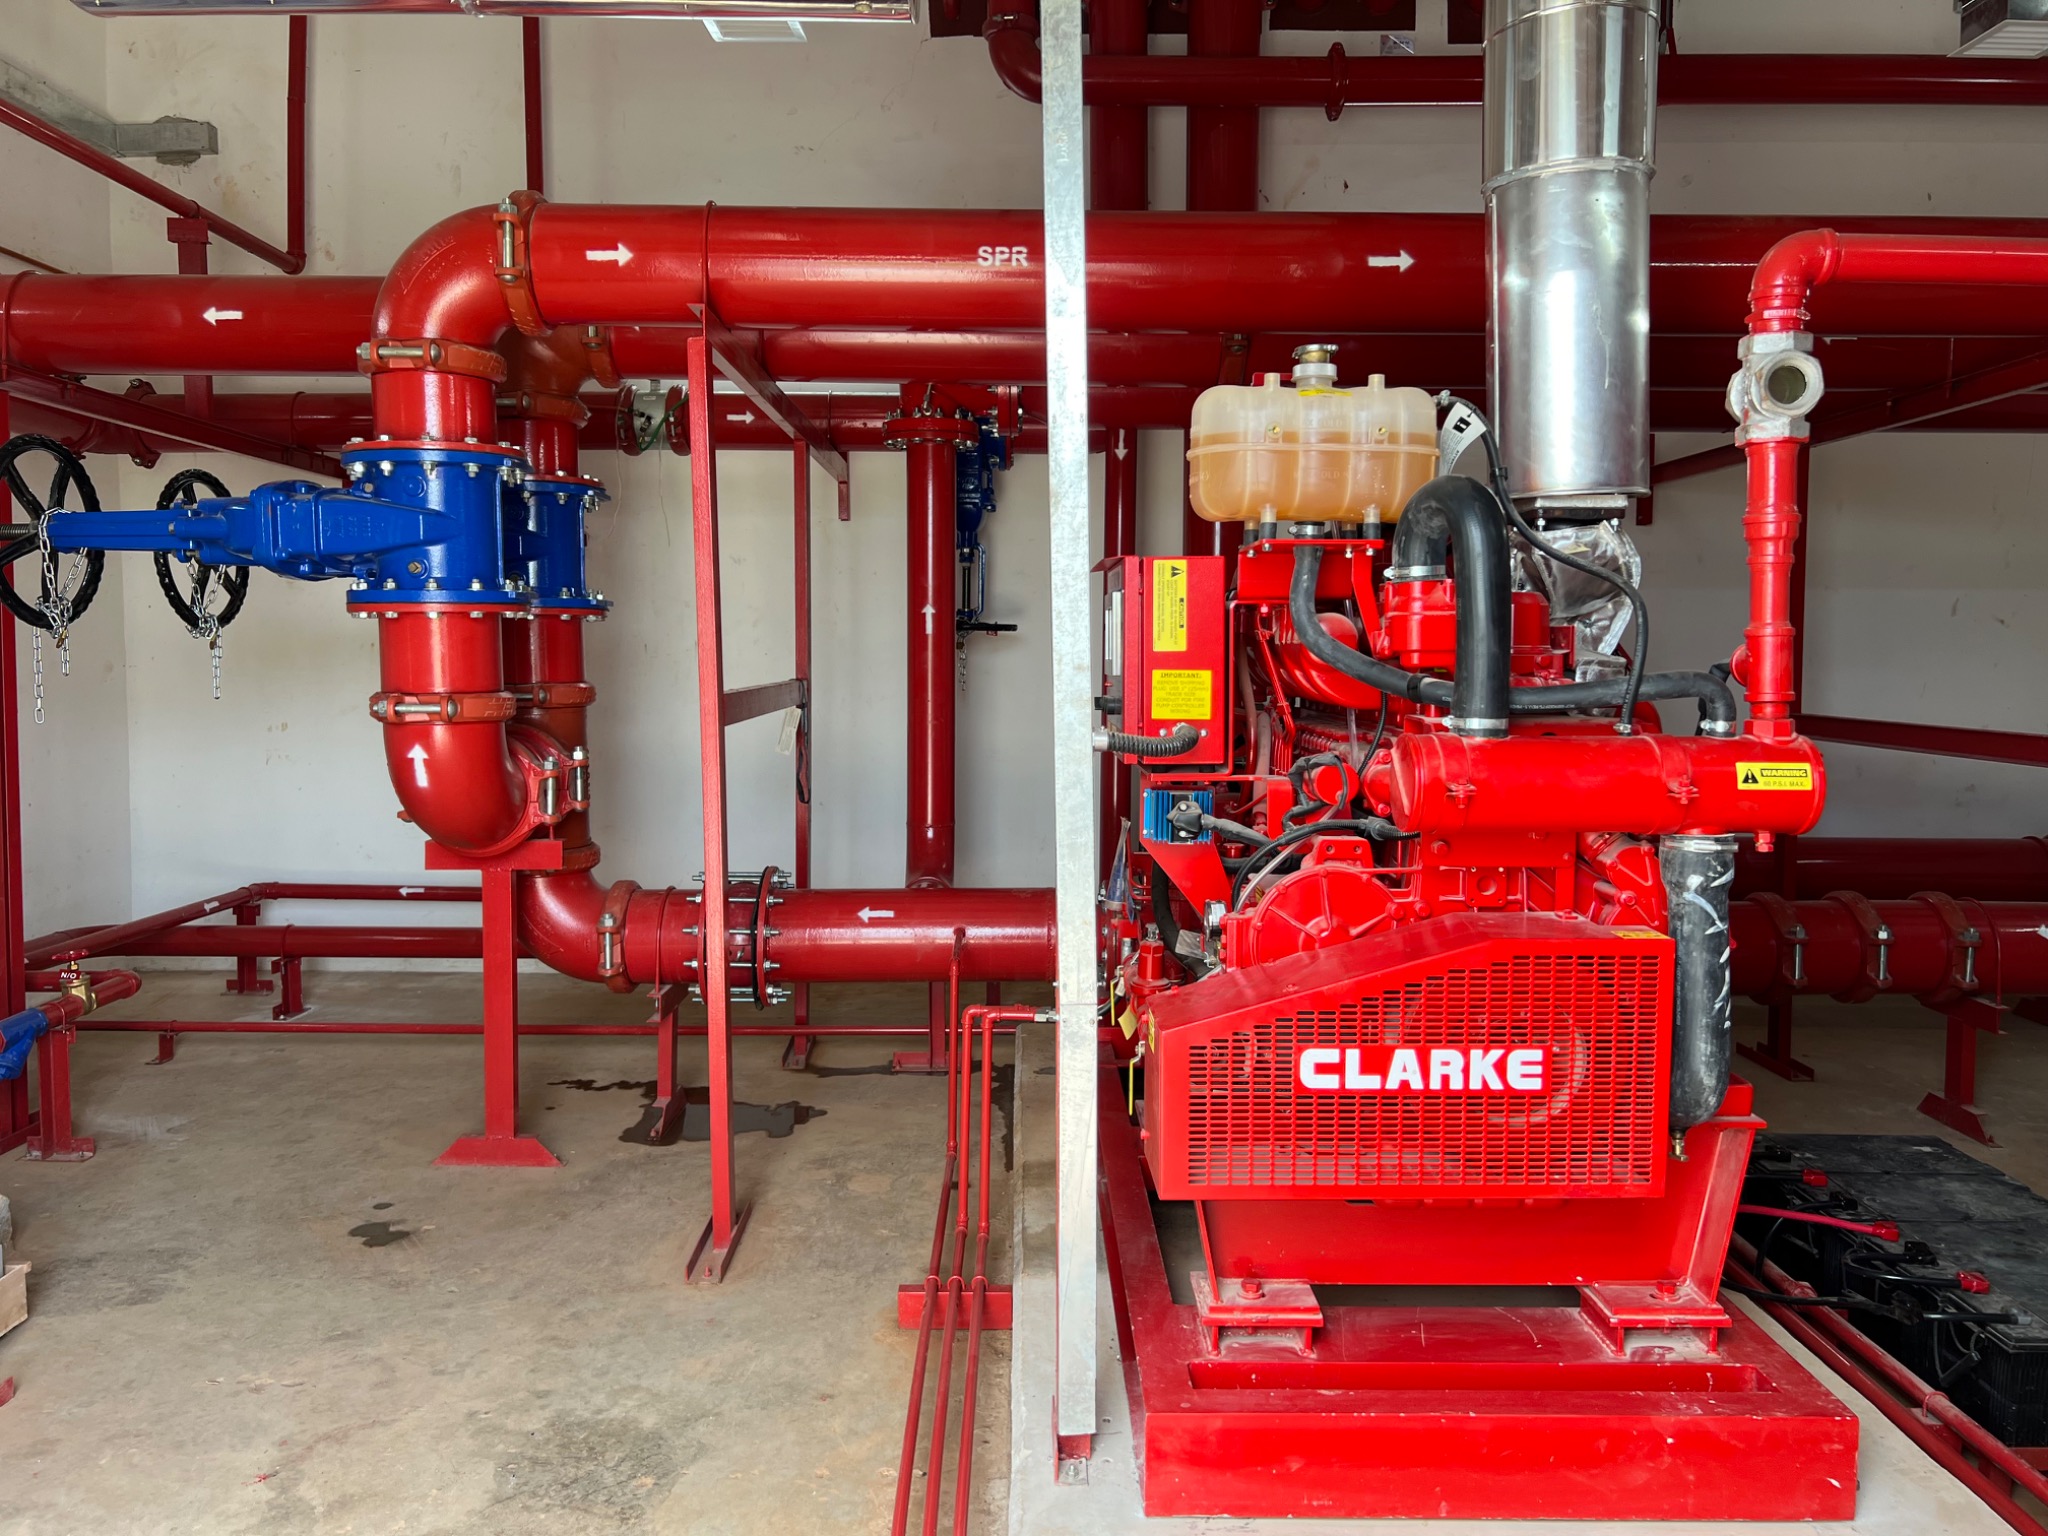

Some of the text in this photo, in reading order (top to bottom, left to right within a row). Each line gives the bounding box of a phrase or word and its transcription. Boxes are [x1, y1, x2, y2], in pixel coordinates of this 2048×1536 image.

[978, 246, 1028, 267] SPR
[1761, 769, 1807, 777] WARNING
[1299, 1048, 1543, 1090] CLARKE
